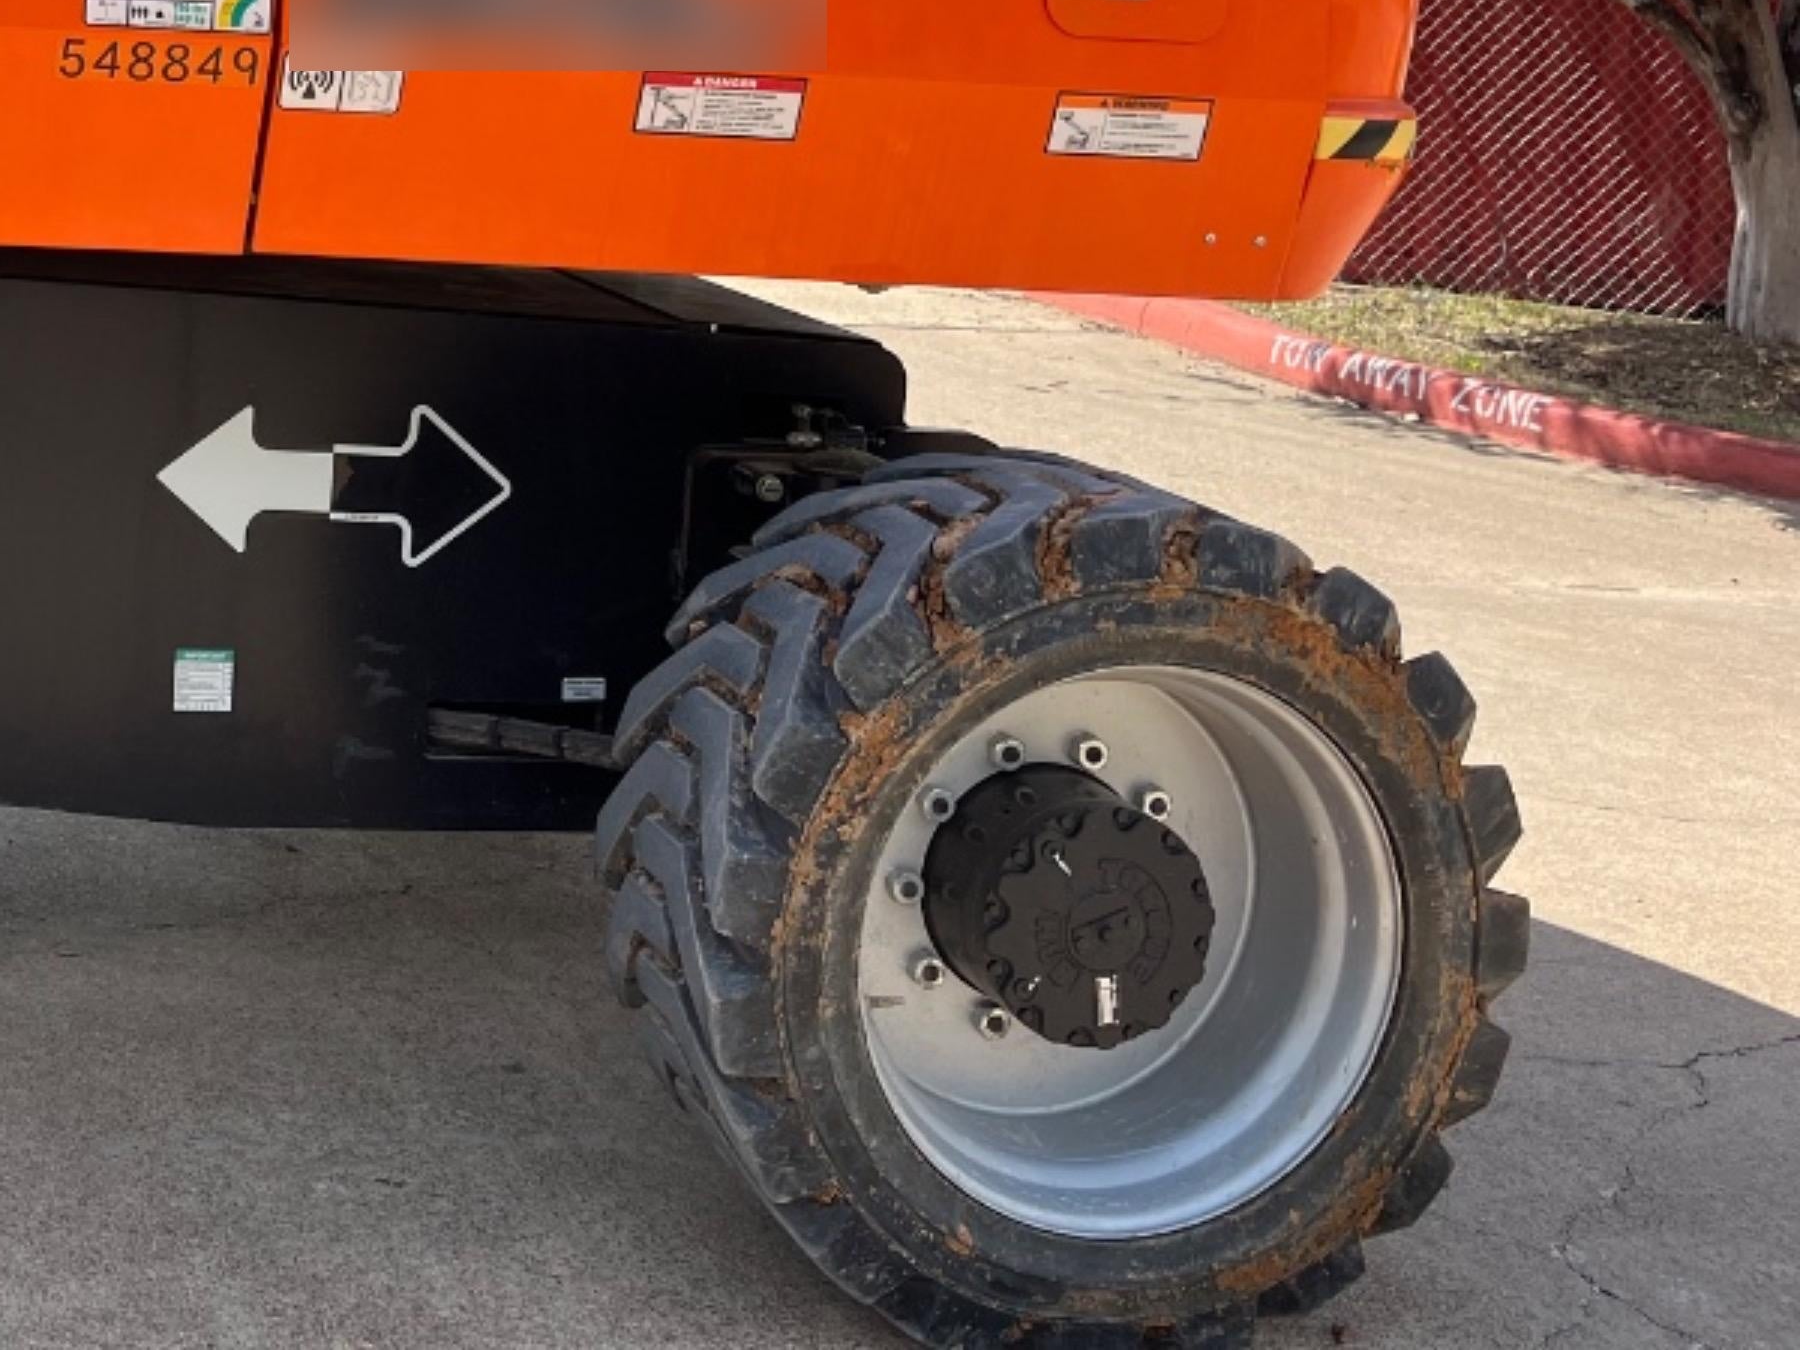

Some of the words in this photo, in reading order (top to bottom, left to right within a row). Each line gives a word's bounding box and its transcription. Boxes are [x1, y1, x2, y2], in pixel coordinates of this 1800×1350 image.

[59, 37, 259, 86] 548849
[1269, 334, 1334, 373] TOW
[1451, 377, 1554, 433] ZONE
